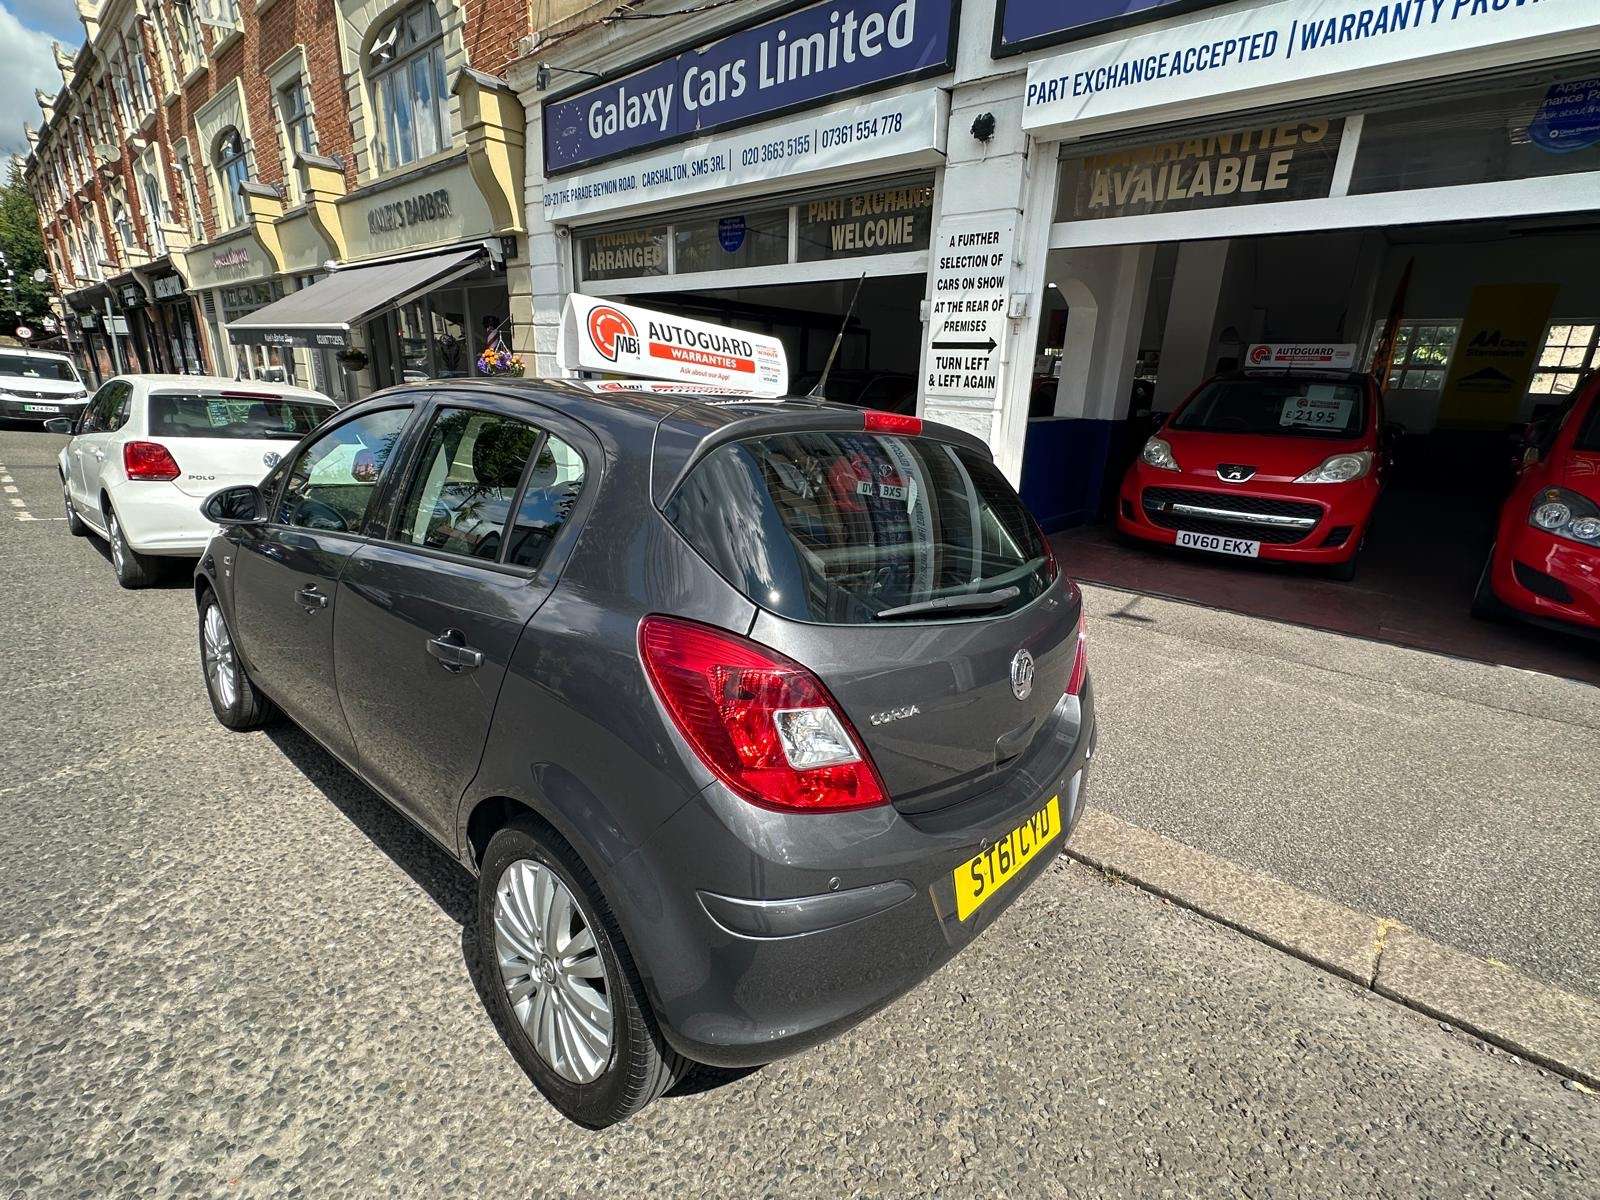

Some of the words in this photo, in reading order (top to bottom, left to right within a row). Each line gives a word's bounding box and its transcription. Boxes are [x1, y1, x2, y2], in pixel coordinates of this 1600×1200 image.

[1027, 76, 1069, 106] PART
[1072, 53, 1169, 97] EXCHANGE
[1169, 30, 1279, 76] ACCEPTED
[1301, 0, 1444, 50] WARRANTY
[588, 84, 674, 139] Galaxy
[682, 59, 746, 111] Cars
[759, 0, 916, 89] Limited
[559, 192, 570, 203] THE
[570, 185, 592, 202] PARADE
[593, 180, 617, 197] BEYNON
[642, 163, 689, 187] CARSHALTON,
[691, 158, 709, 177] SM5
[710, 154, 726, 173] 3RL
[742, 147, 759, 166] 020
[761, 141, 784, 162] 3663
[787, 135, 810, 156] 5155
[822, 124, 853, 148] 07361
[856, 119, 877, 141] 554
[882, 112, 902, 134] 778
[1088, 150, 1293, 208] AVAILABLE
[832, 216, 914, 250] WELCOME
[949, 236, 956, 247] A
[958, 232, 999, 246] FURTHER
[590, 246, 663, 271] ARRANGED
[940, 256, 988, 269] SELECTION
[991, 254, 1003, 266] OF
[937, 278, 959, 291] CARS
[962, 278, 975, 290] ON
[977, 276, 1004, 289] SHOW
[934, 302, 945, 313] AT
[947, 301, 963, 312] THE
[966, 300, 988, 312] REAR
[991, 299, 1004, 311] OF
[944, 320, 987, 332] PREMISES
[649, 322, 752, 357] AUTOGUARD
[671, 348, 737, 368] WARRANTIES
[936, 357, 962, 370] TURN
[965, 357, 989, 370] LEFT
[928, 374, 936, 387] &
[938, 375, 961, 387] LEFT
[963, 376, 995, 389] AGAIN
[1182, 533, 1219, 549] OV60
[1223, 540, 1253, 554] EKX
[870, 705, 920, 726] CORSA
